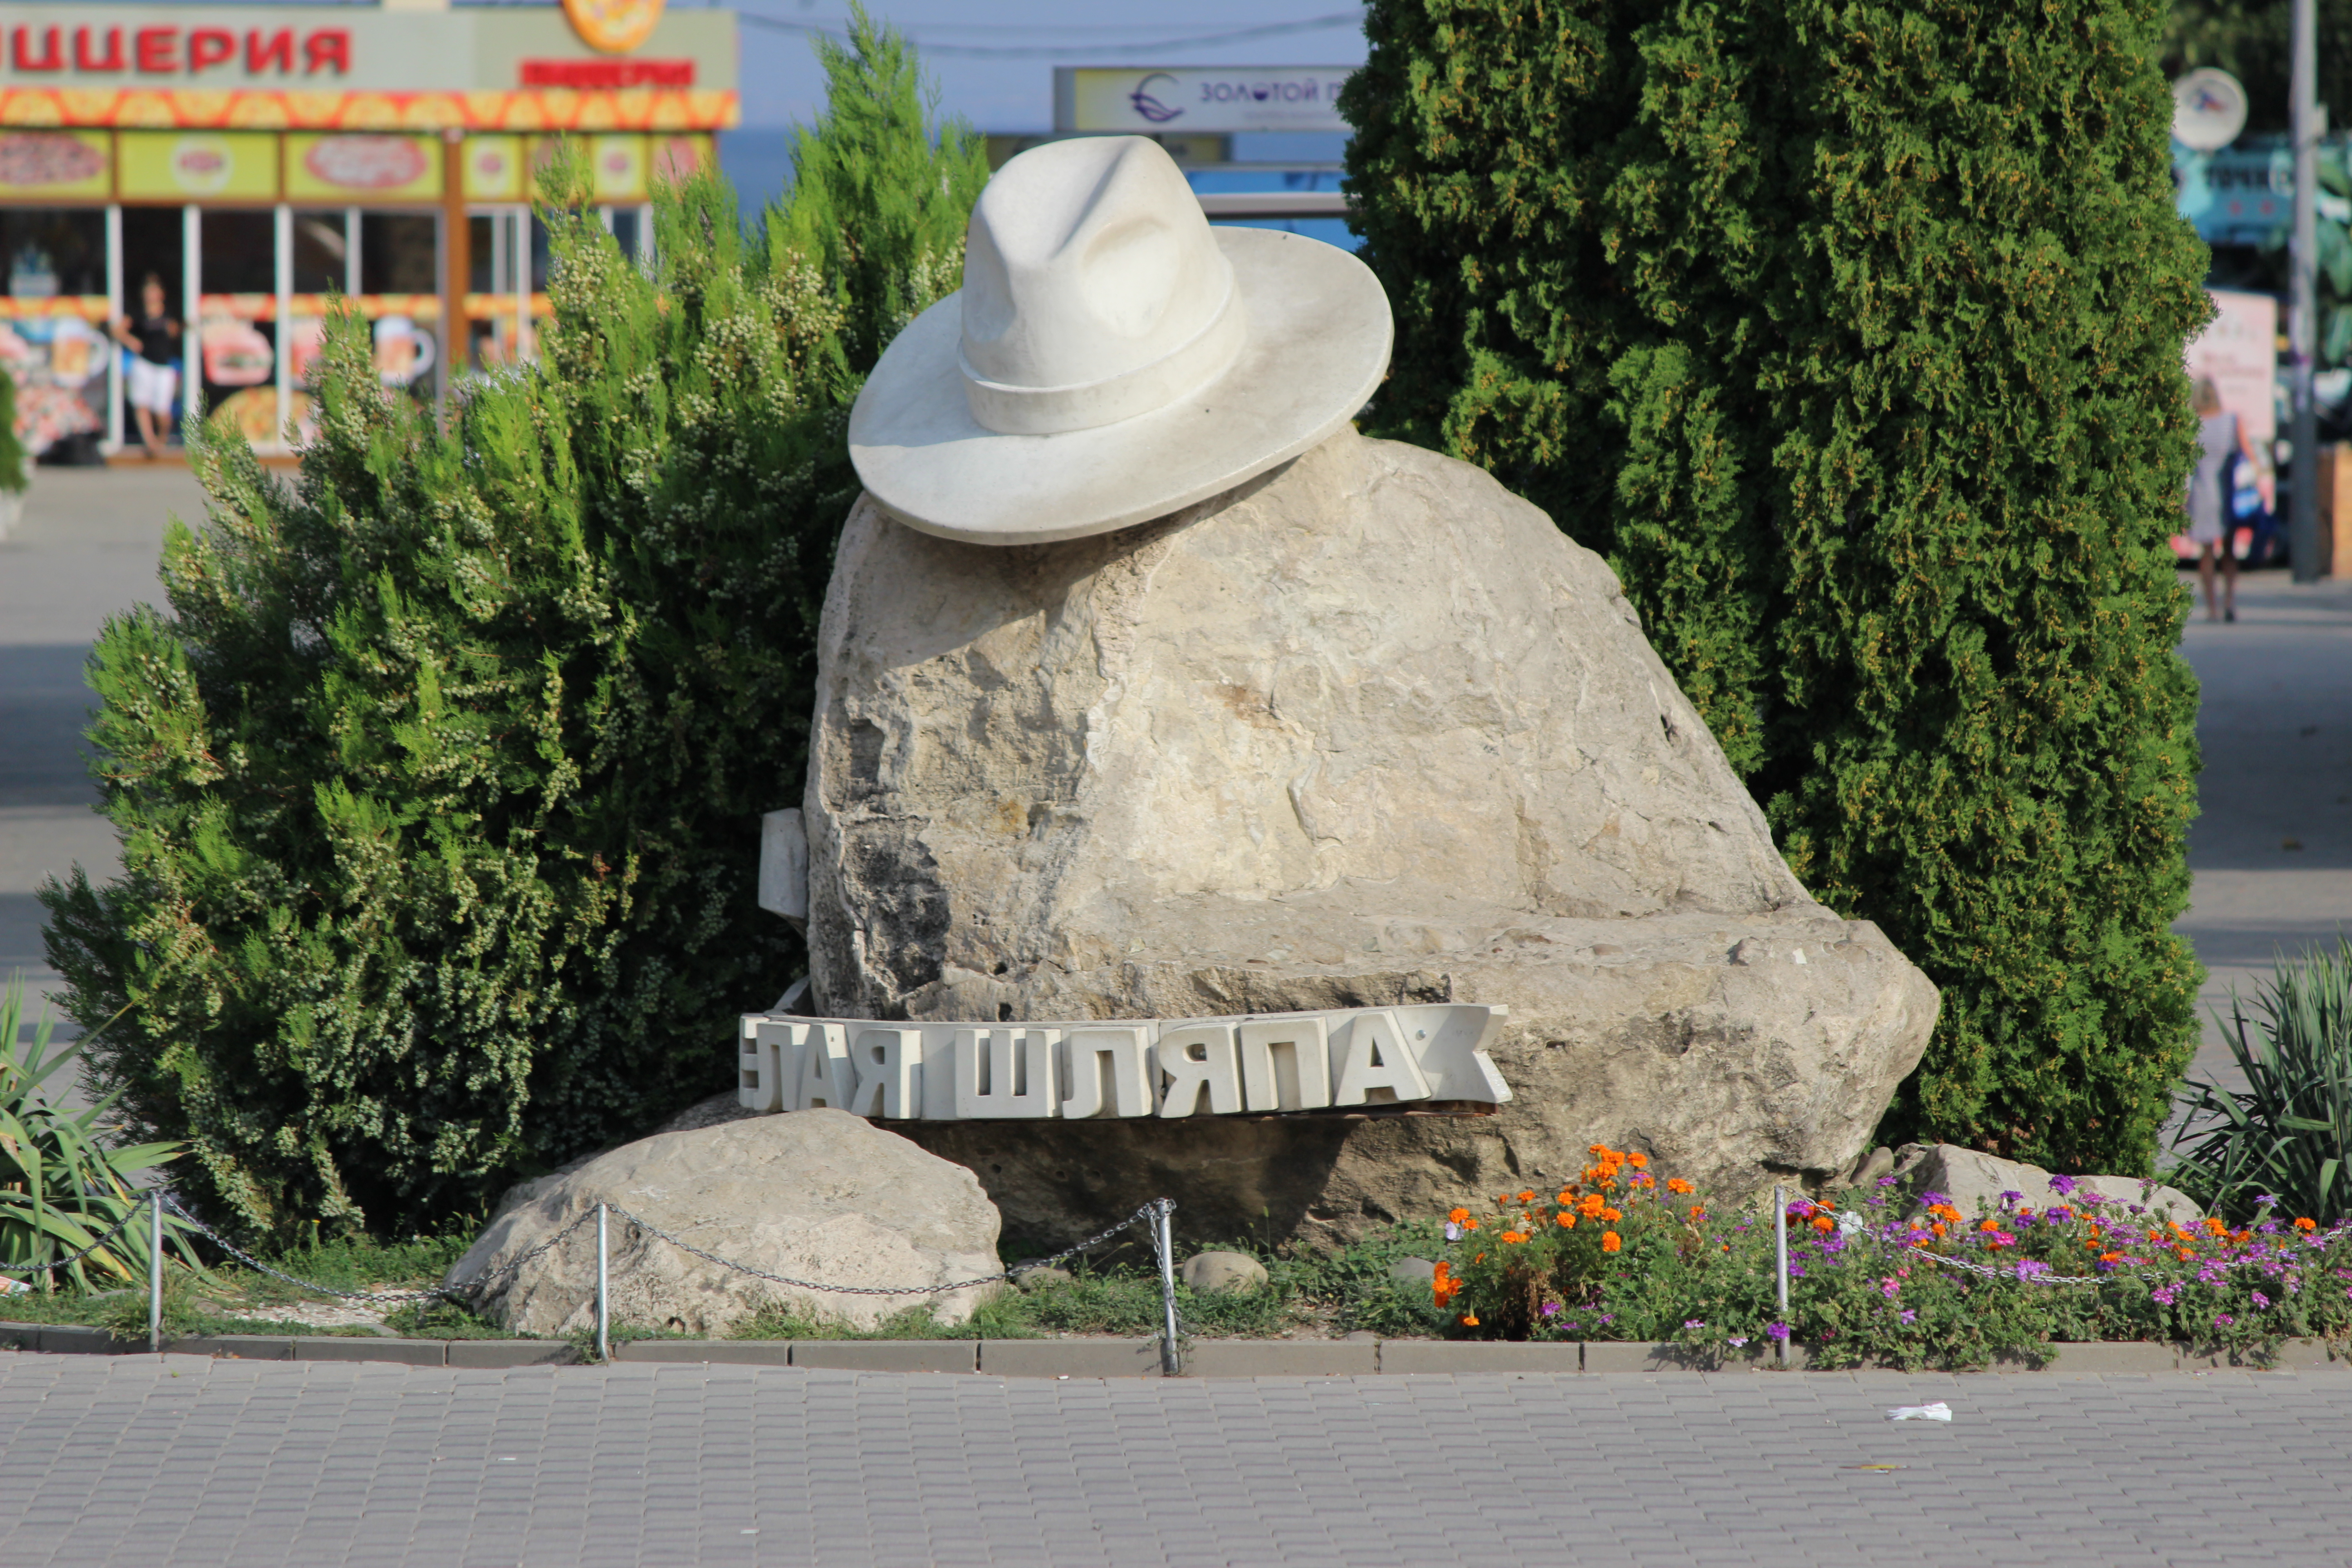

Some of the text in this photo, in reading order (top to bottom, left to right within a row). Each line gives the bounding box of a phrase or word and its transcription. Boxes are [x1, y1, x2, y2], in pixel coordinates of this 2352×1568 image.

[0, 25, 353, 73] ЦЦЕРИЯ
[1200, 78, 1319, 102] ЗОЛОТОЙ
[956, 1010, 1431, 1119] ШЛЯПА
